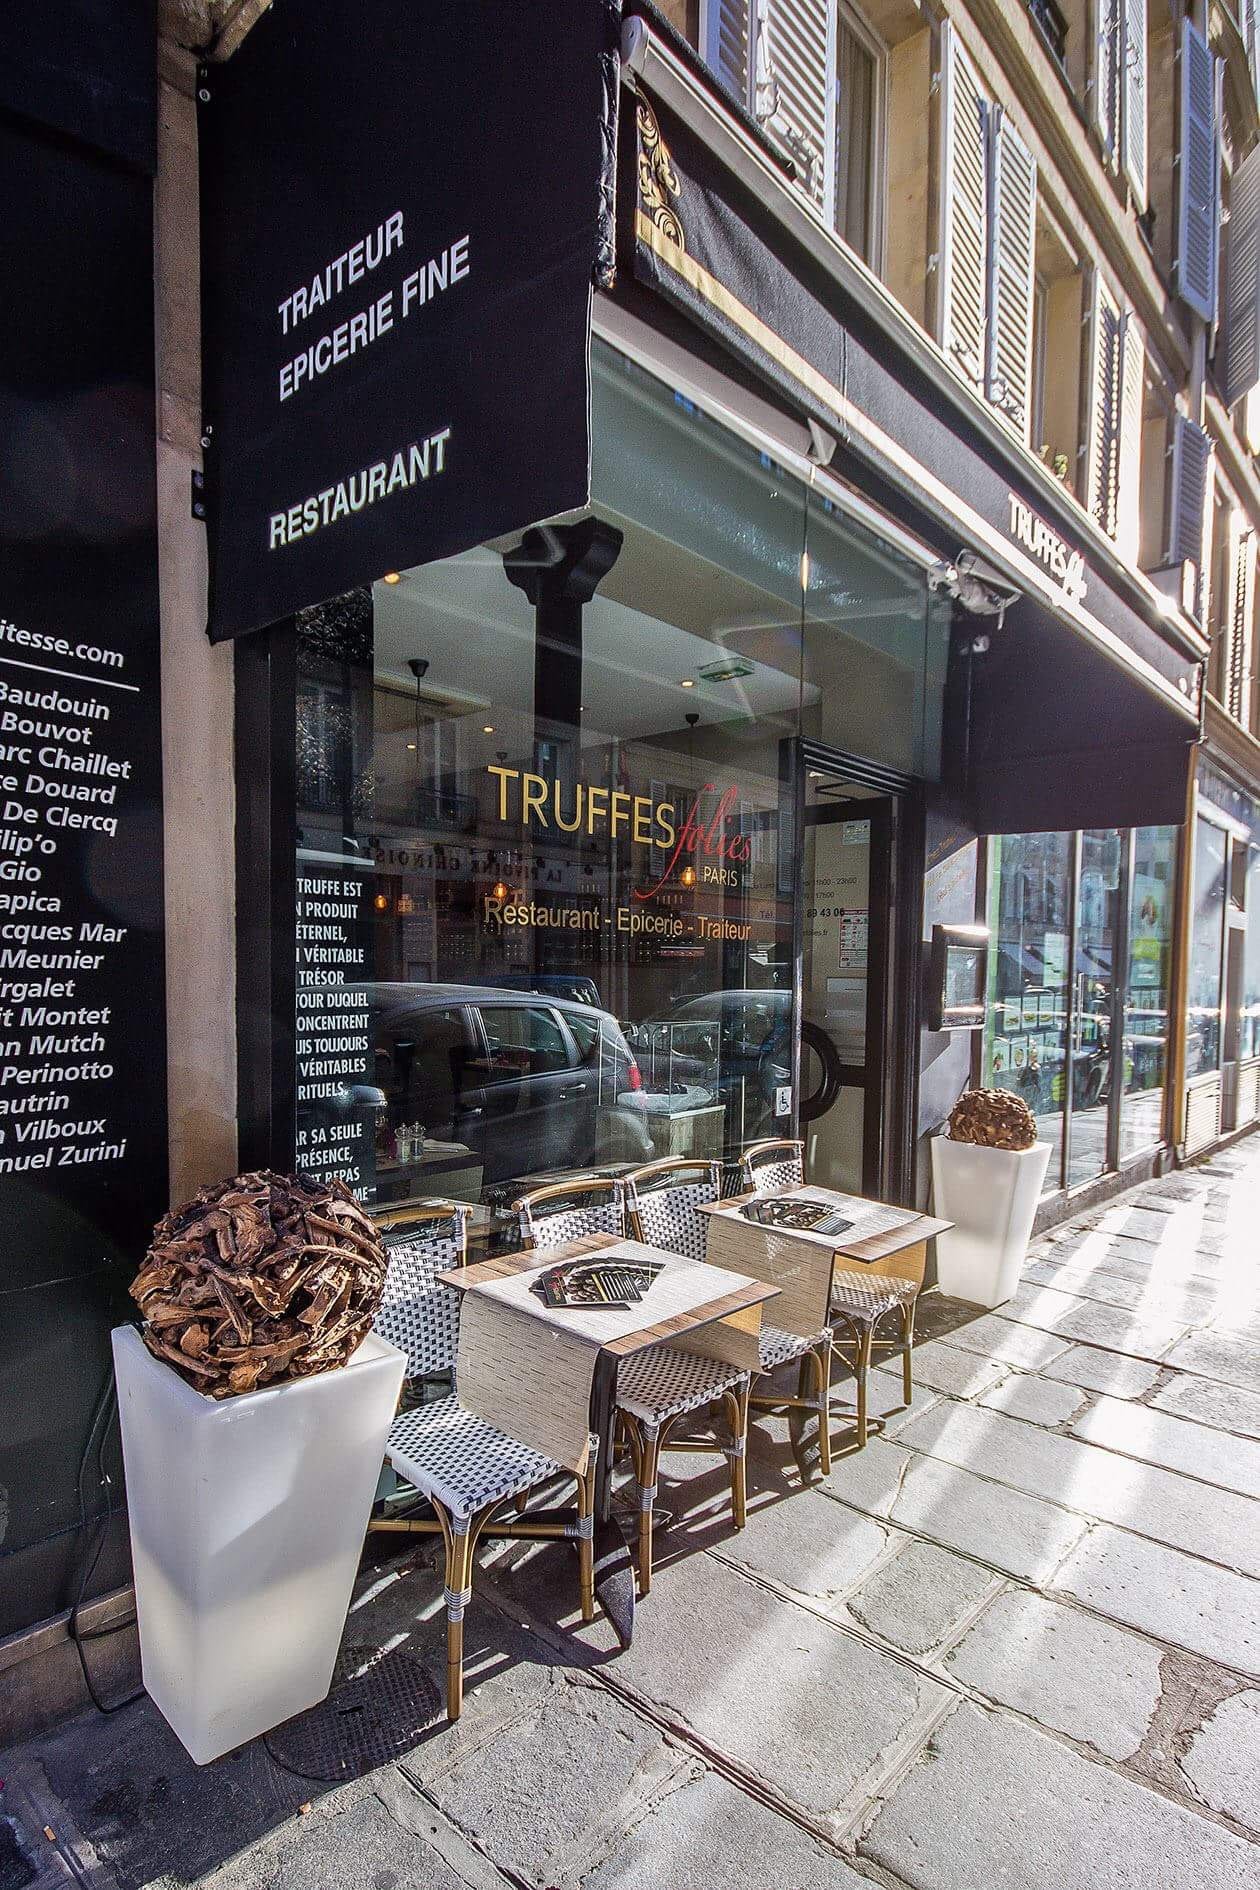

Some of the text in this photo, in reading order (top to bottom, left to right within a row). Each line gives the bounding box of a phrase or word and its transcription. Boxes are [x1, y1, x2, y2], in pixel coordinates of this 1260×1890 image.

[278, 210, 404, 335] TRAITEUR
[279, 235, 470, 402] EPICERIE FINE
[269, 427, 451, 550] RESTAURANT
[0, 620, 124, 668] itesse.com
[1, 711, 93, 745] Bouvot
[38, 747, 132, 779] Chaillet
[0, 774, 117, 804] e Douard
[3, 801, 118, 837] De Clercq
[487, 764, 751, 900] TRUFFES folies
[0, 860, 42, 882] Gio
[703, 866, 738, 888] PARIS
[296, 878, 363, 898] TRUFFE EST
[306, 902, 358, 919] PRODUIT
[484, 896, 600, 931] Restaurant
[617, 907, 683, 937] Epicerie
[697, 916, 751, 941] Traiteur
[2, 923, 127, 944] cques Mar
[296, 921, 348, 943] ÉTERNEL,
[0, 949, 104, 970] Meunier
[304, 944, 364, 963] VÉRITABLE
[299, 967, 345, 986] TRÉSOR
[0, 978, 76, 1003] rgalet
[327, 992, 369, 1008] DUQUEL
[20, 1006, 111, 1026] Montet
[296, 1014, 369, 1032] ONCENTRENT
[29, 1032, 105, 1055] Mutch
[296, 1035, 368, 1055] UIS TOUJOURS
[1, 1062, 114, 1086] Perinotto
[300, 1057, 366, 1078] VÉRITABLES
[14, 1118, 107, 1142] Vilboux
[311, 1128, 327, 1144] SA
[330, 1123, 363, 1142] SEULE
[0, 1139, 128, 1173] nuel Zurini
[296, 1146, 354, 1168] PRÉSENCE,
